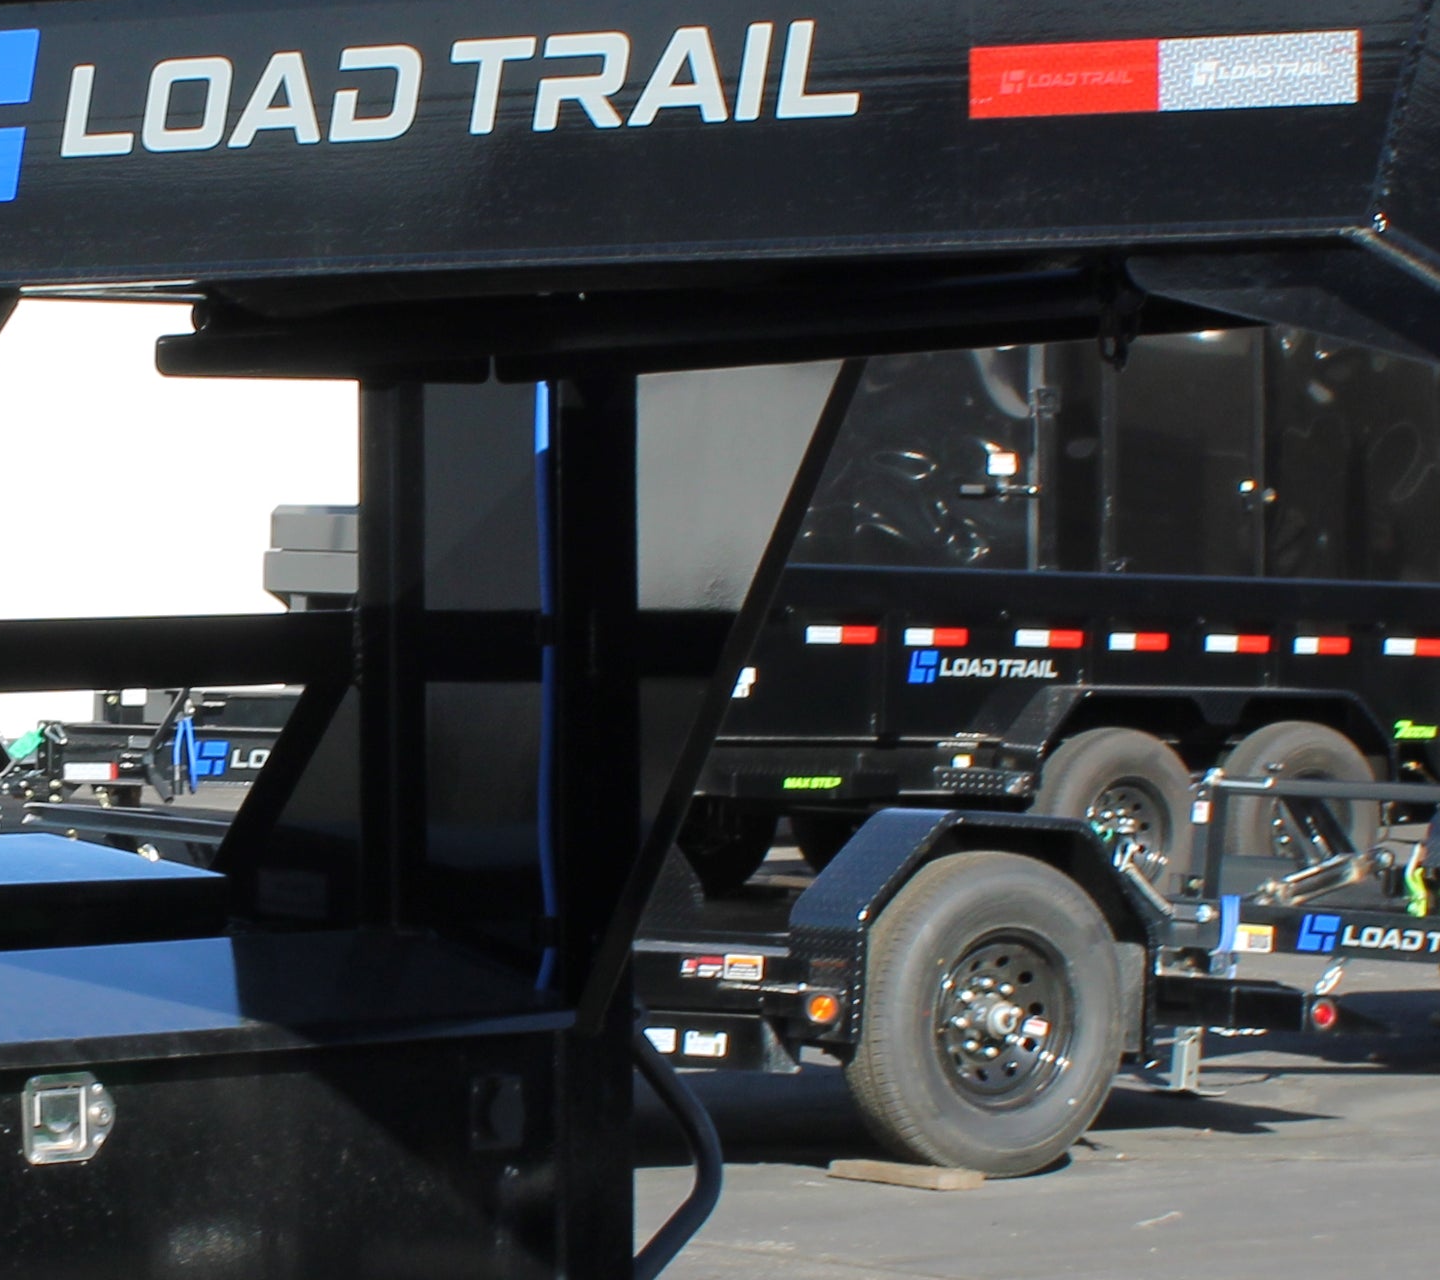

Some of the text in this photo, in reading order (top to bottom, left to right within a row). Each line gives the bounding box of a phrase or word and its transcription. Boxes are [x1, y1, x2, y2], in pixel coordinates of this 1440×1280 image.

[59, 19, 862, 158] LOAD TRAIL
[938, 657, 1060, 679] LOAD TRAIL
[229, 748, 272, 769] LO
[1340, 924, 1423, 952] LOAD
